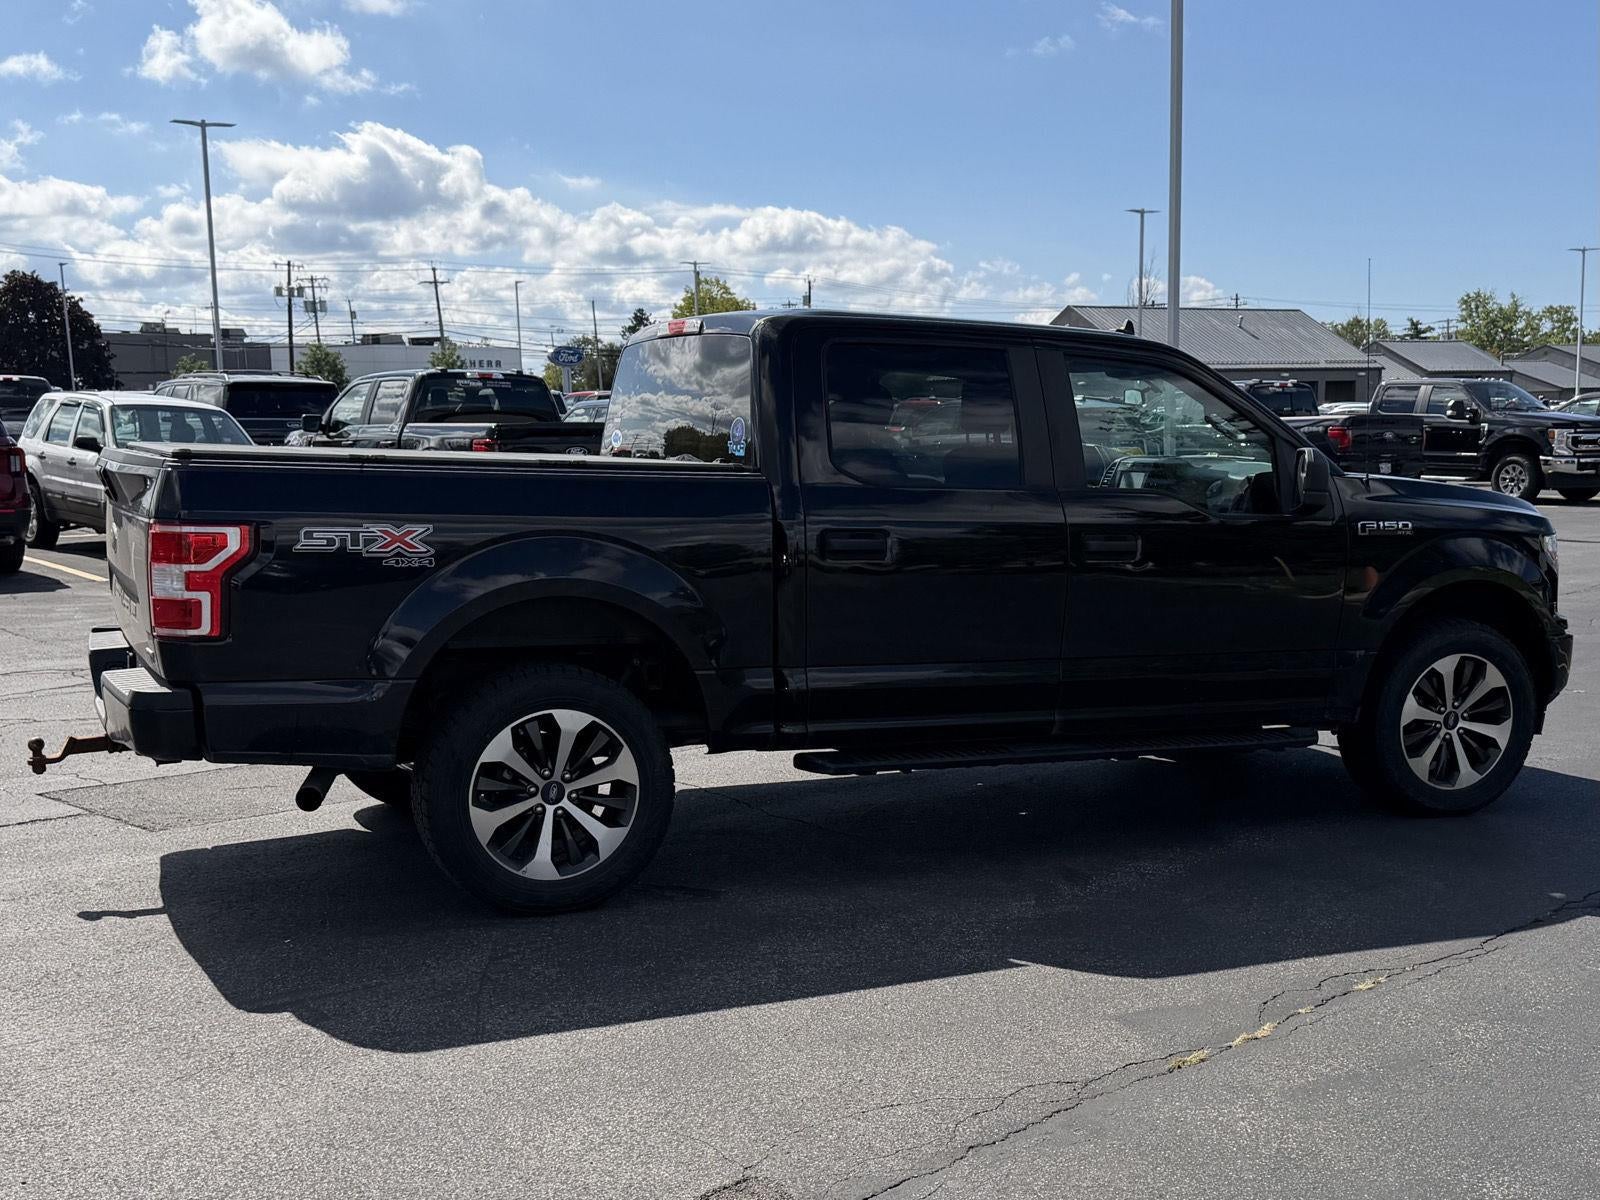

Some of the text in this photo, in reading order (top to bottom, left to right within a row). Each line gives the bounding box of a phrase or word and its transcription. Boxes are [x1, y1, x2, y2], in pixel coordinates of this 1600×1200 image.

[558, 350, 579, 362] Ford
[469, 359, 502, 368] HERR
[293, 524, 436, 557] STX
